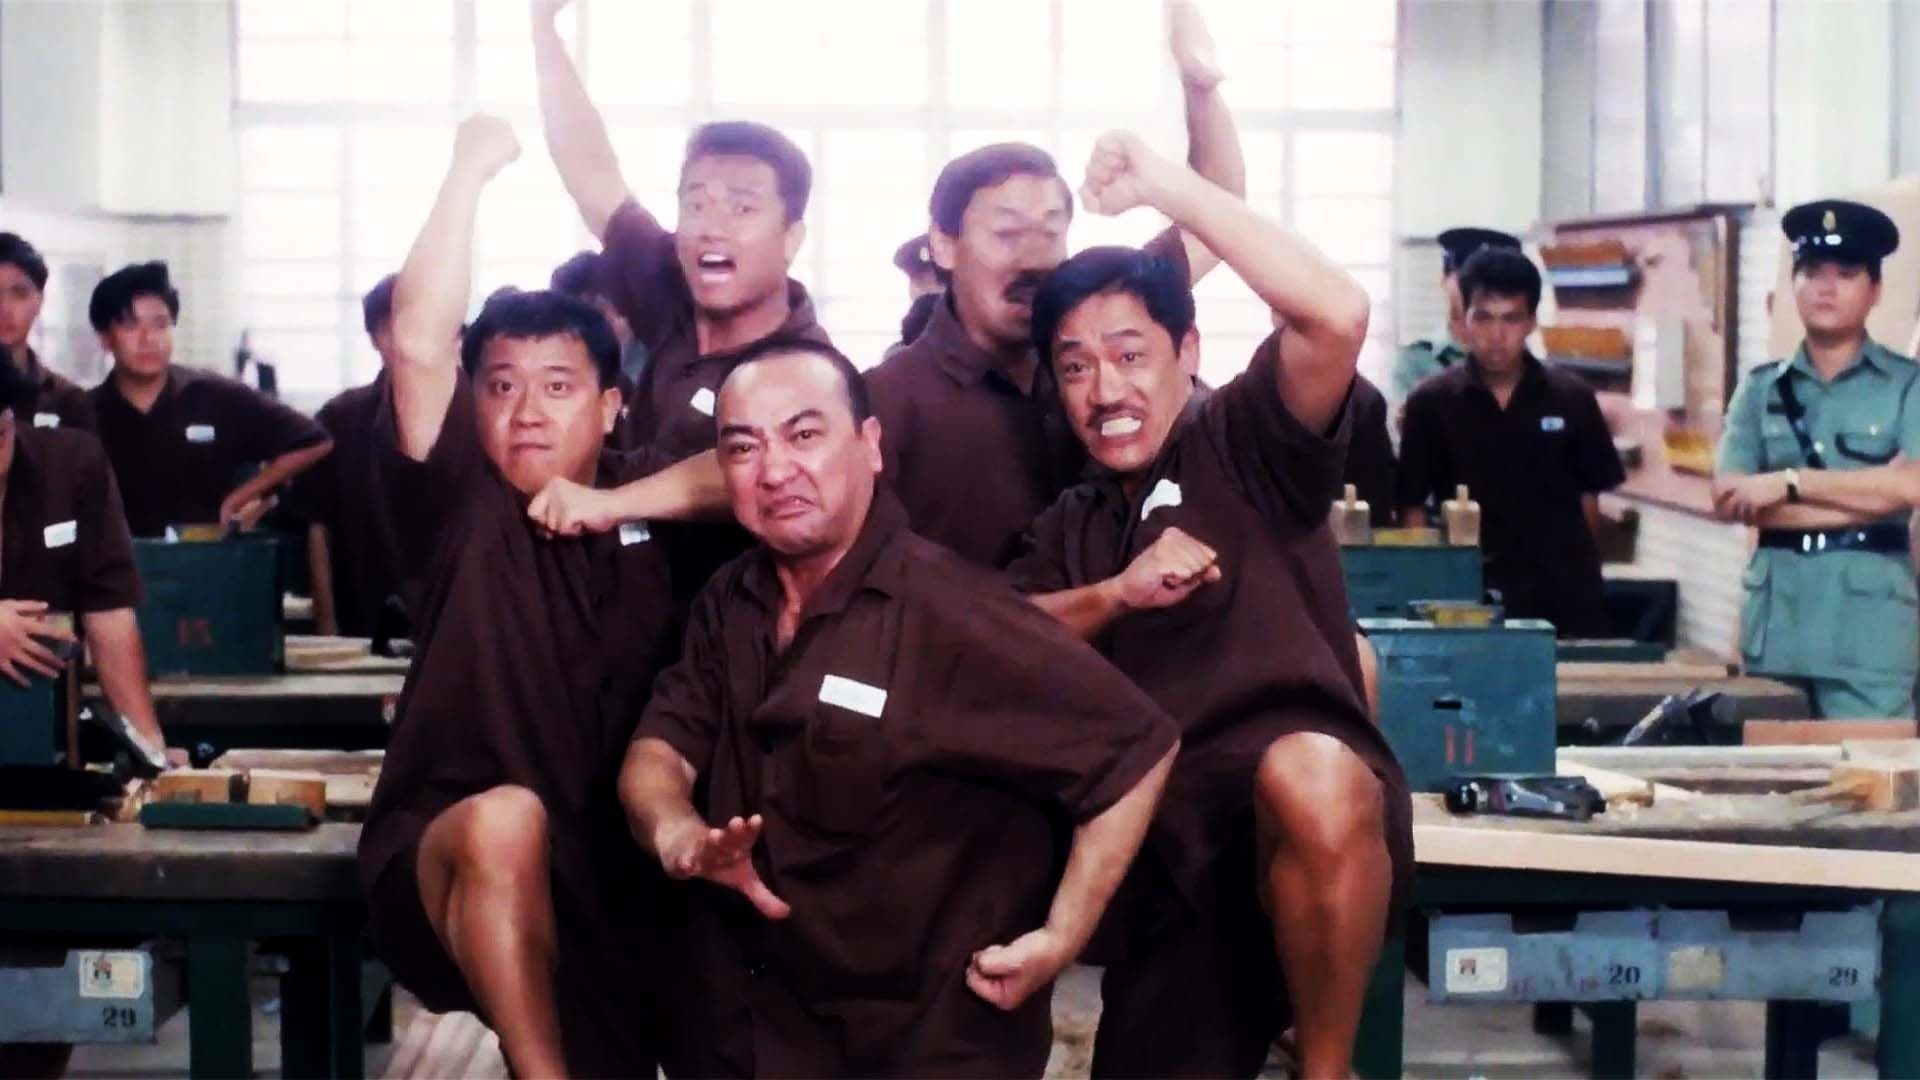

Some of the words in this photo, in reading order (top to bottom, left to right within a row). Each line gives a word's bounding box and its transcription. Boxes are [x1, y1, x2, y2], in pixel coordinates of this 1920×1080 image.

[1608, 964, 1641, 986] 20
[1828, 966, 1859, 986] 29
[103, 1006, 137, 1028] 29
